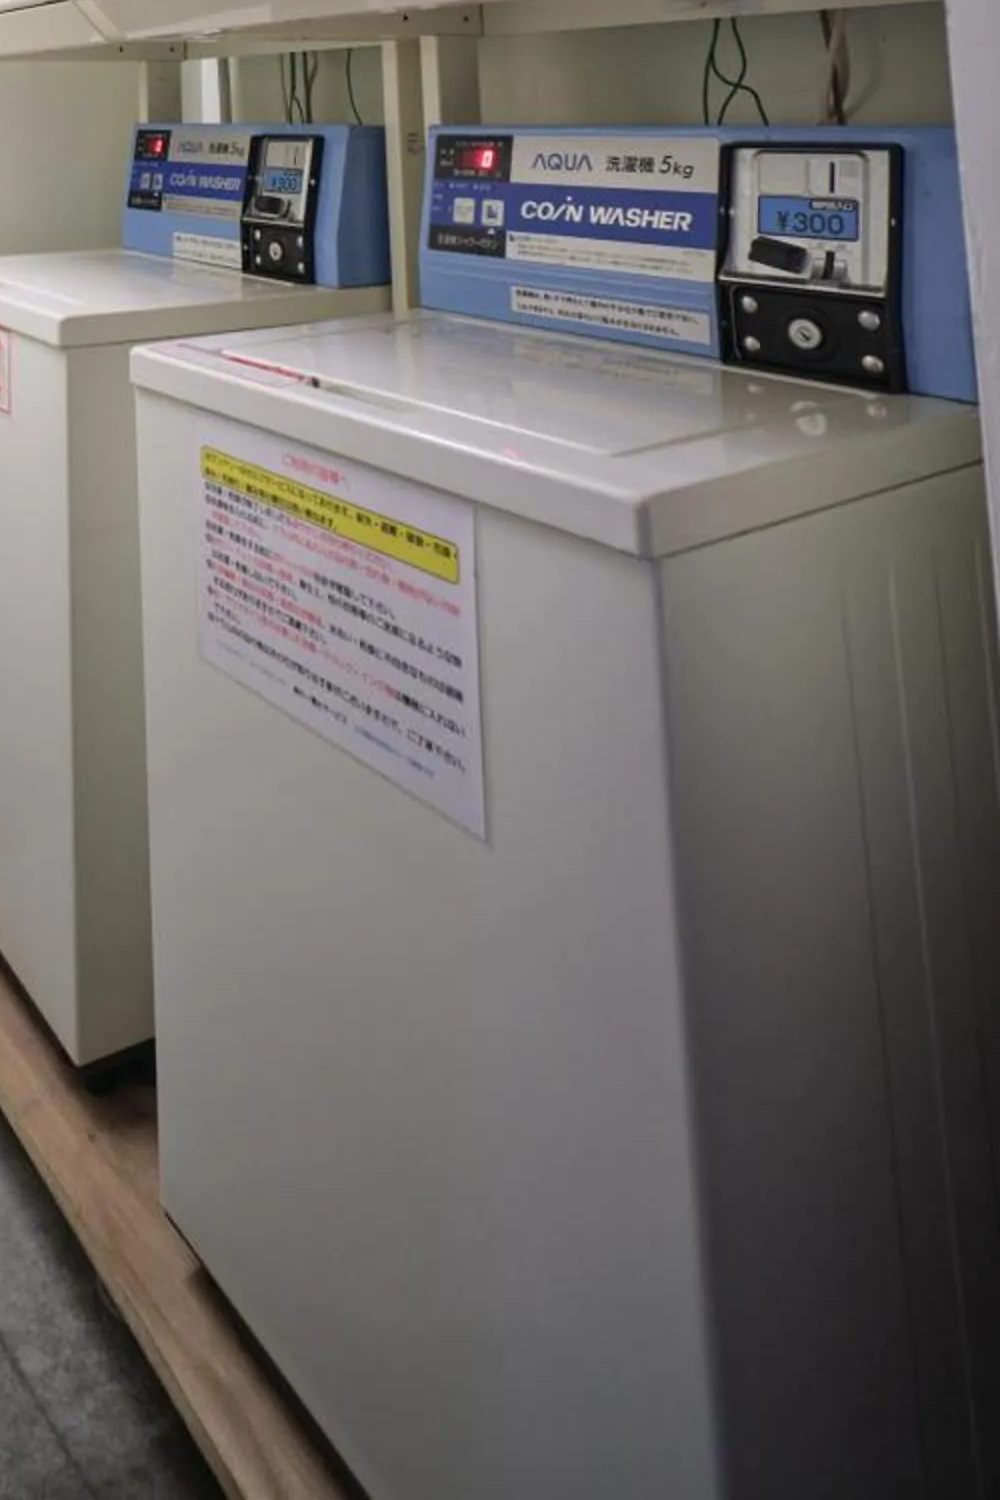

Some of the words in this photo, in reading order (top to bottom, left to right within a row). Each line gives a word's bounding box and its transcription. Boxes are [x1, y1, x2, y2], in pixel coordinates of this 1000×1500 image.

[532, 153, 593, 172] AQUA
[605, 155, 655, 173] 洗濯機
[658, 155, 695, 179] 5kg
[590, 206, 693, 232] WASHER
[776, 210, 845, 236] ¥300
